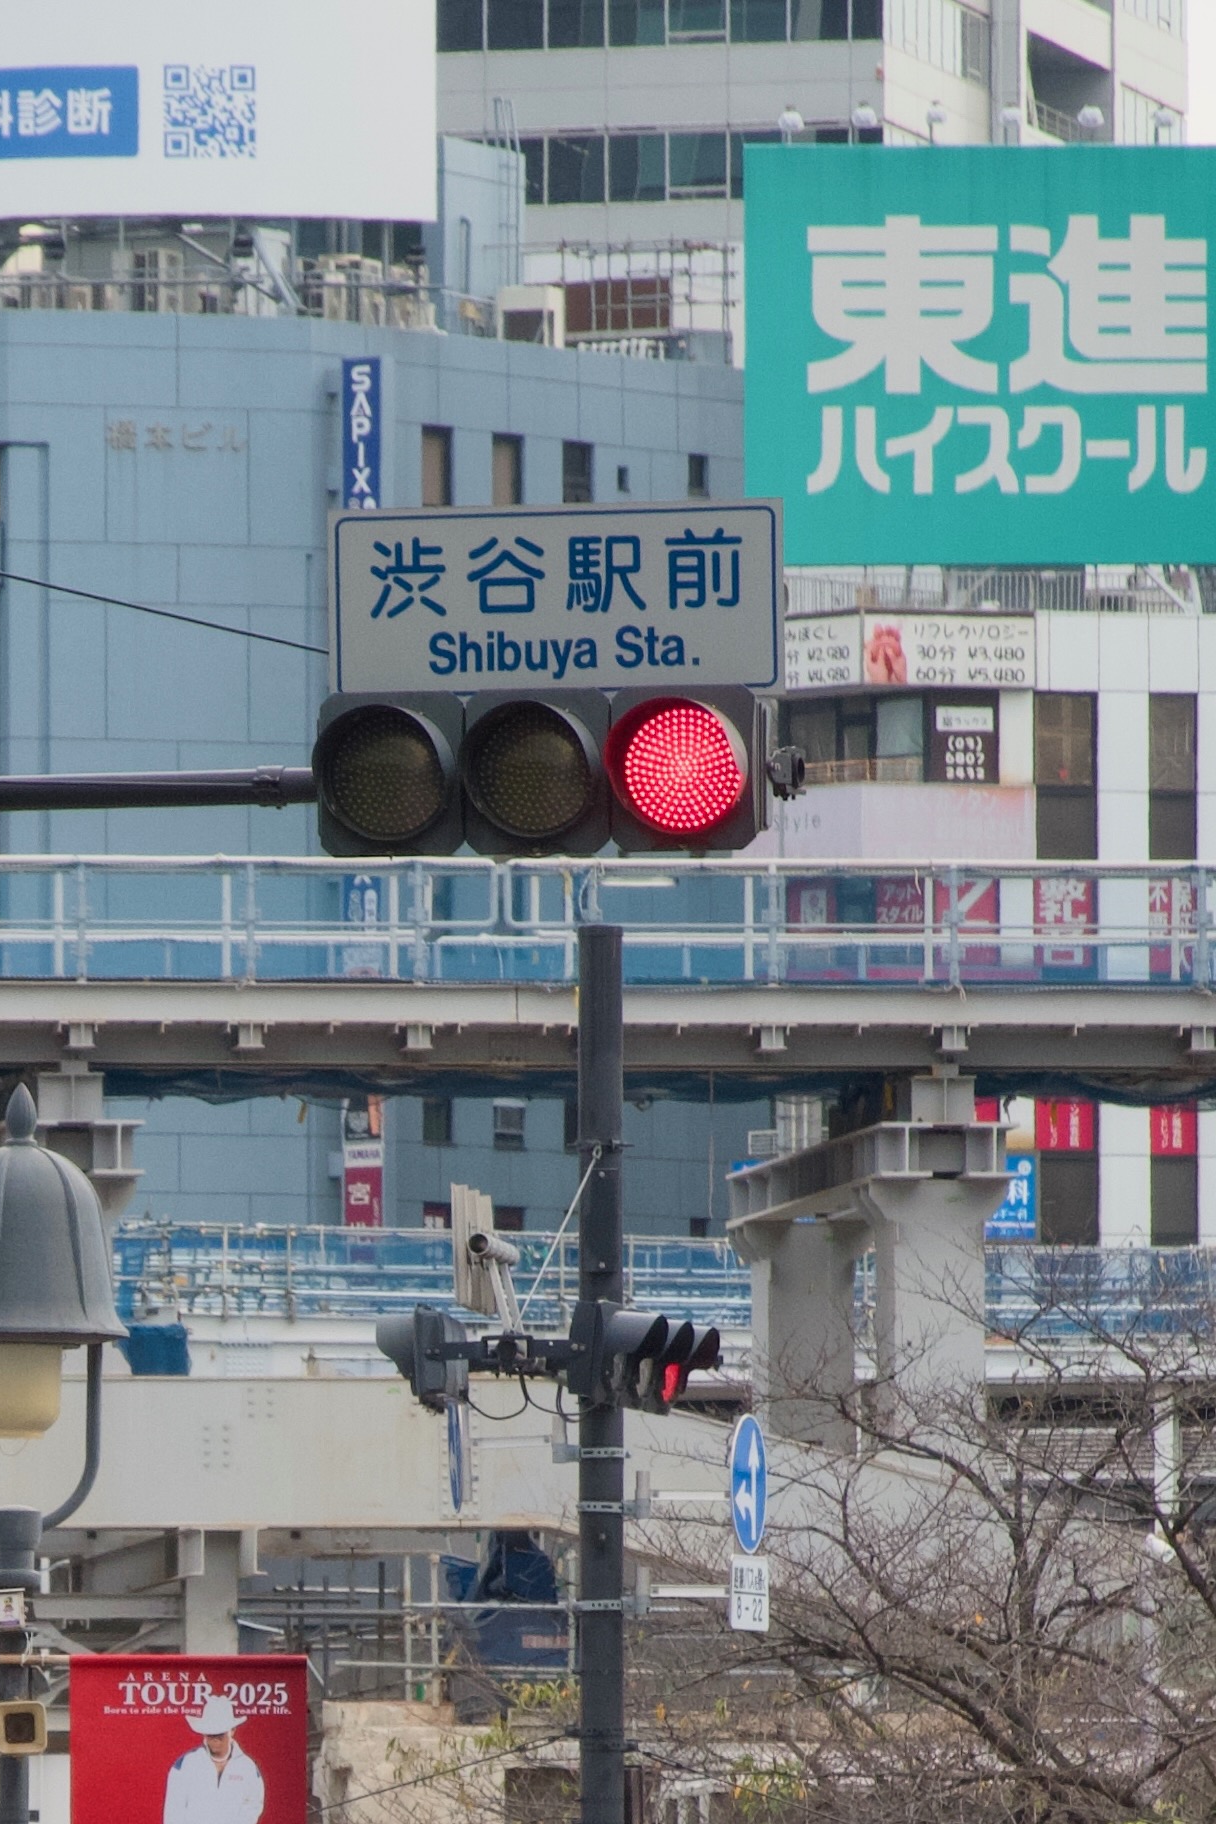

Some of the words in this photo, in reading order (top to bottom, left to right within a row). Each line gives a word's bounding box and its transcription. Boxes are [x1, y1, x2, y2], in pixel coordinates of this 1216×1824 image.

[806, 214, 1208, 396] 東進
[350, 364, 372, 494] SAPIX
[806, 406, 1207, 496] ハイスクール
[370, 527, 744, 619] 渋谷駅前
[428, 631, 598, 680] Shibuya
[614, 625, 700, 669] Sta.
[103, 1705, 128, 1715] Born
[128, 1706, 139, 1715] to
[141, 1705, 162, 1715] ride
[163, 1705, 179, 1715] the
[180, 1705, 202, 1716] long
[235, 1705, 259, 1715] road
[259, 1705, 271, 1715] of
[118, 1681, 213, 1706] TOUR
[223, 1682, 289, 1707] 2025
[126, 1672, 207, 1682] ARENA
